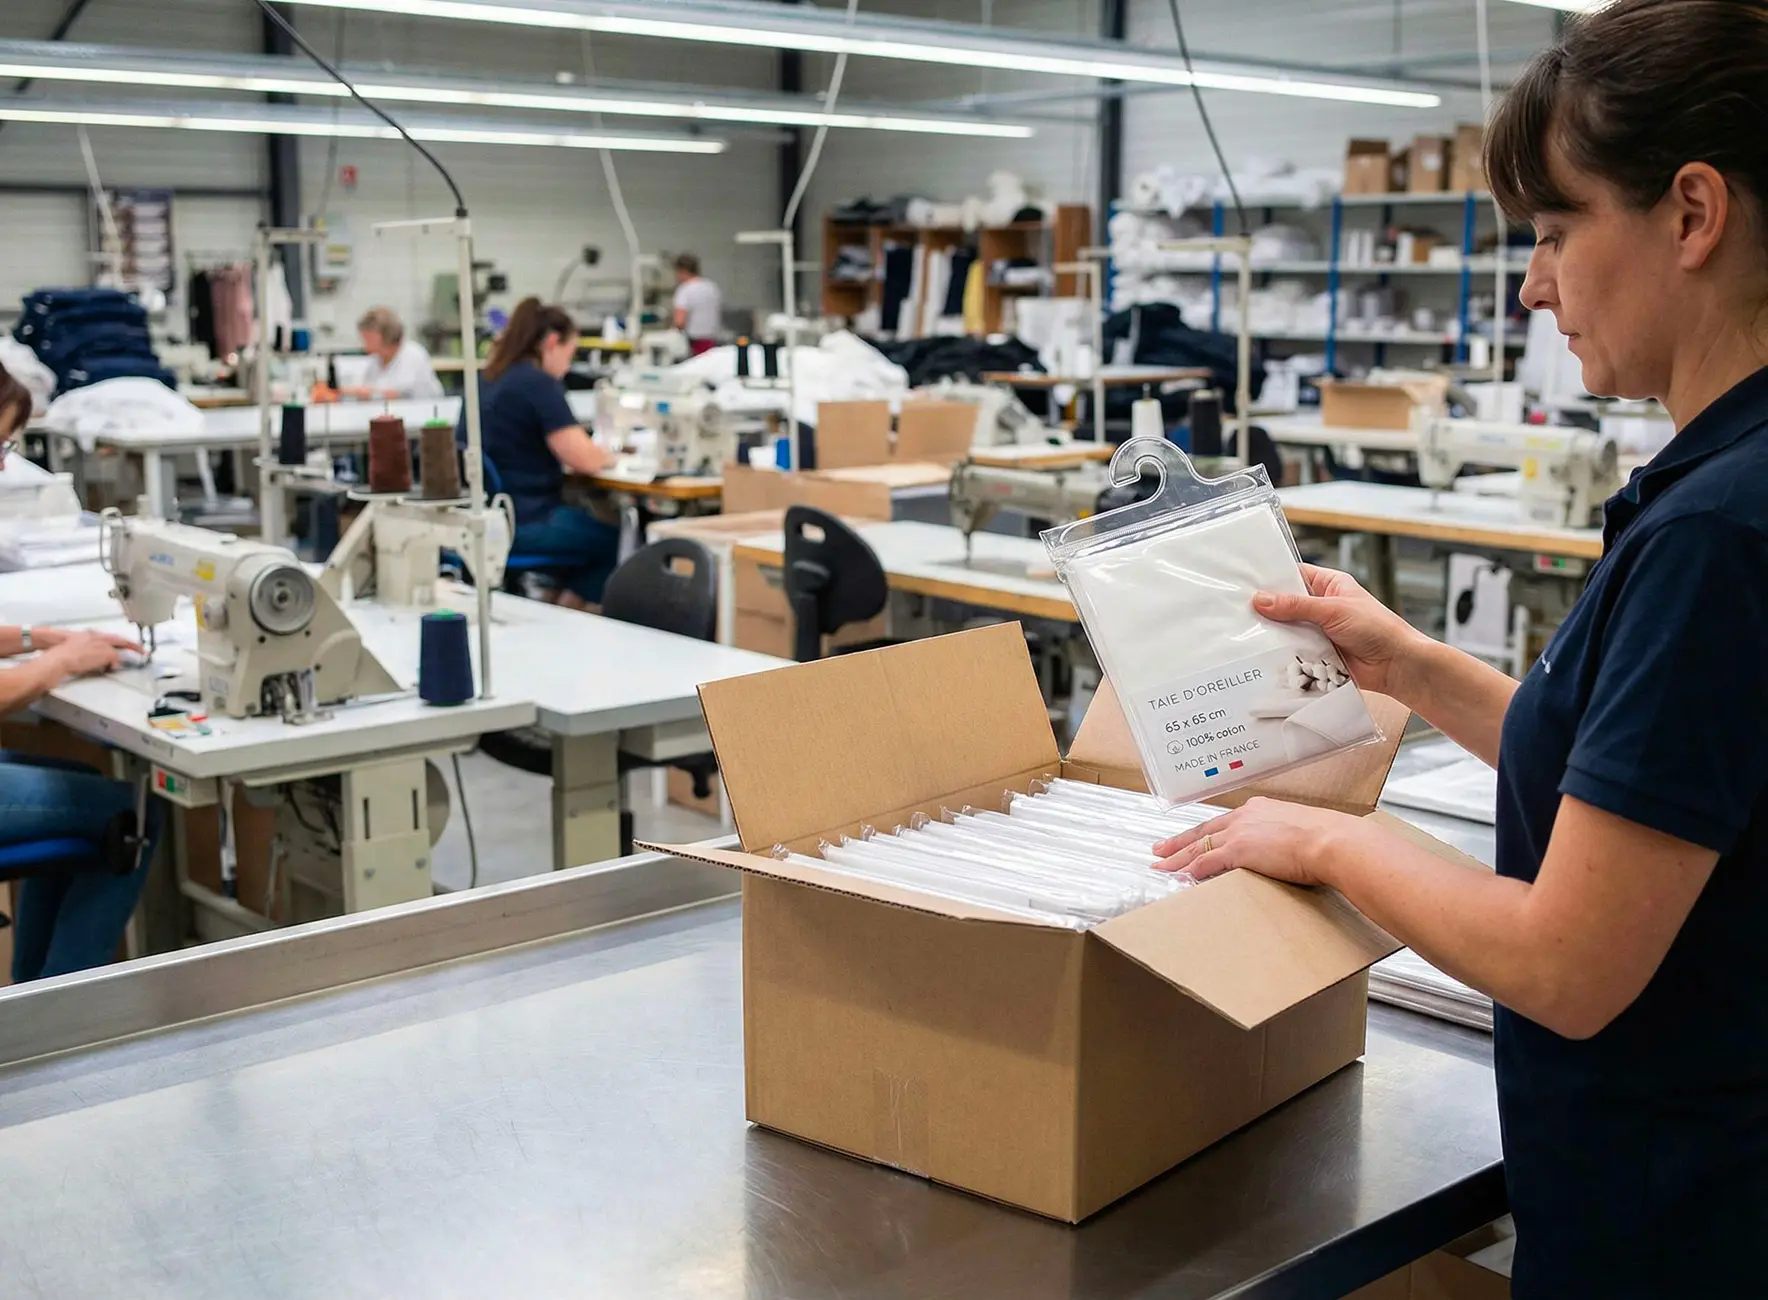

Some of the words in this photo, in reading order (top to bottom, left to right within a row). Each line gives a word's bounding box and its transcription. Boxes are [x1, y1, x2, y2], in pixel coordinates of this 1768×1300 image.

[1148, 693, 1180, 711] TAIE
[1183, 668, 1262, 701] D'OREILLER
[1165, 720, 1181, 733] 65
[1182, 719, 1191, 729] x
[1192, 712, 1207, 726] 65
[1208, 708, 1226, 721] cm
[1186, 731, 1214, 748] 100%
[1174, 756, 1206, 773] MADE
[1207, 752, 1218, 763] IN
[1219, 739, 1260, 759] FRANCE
